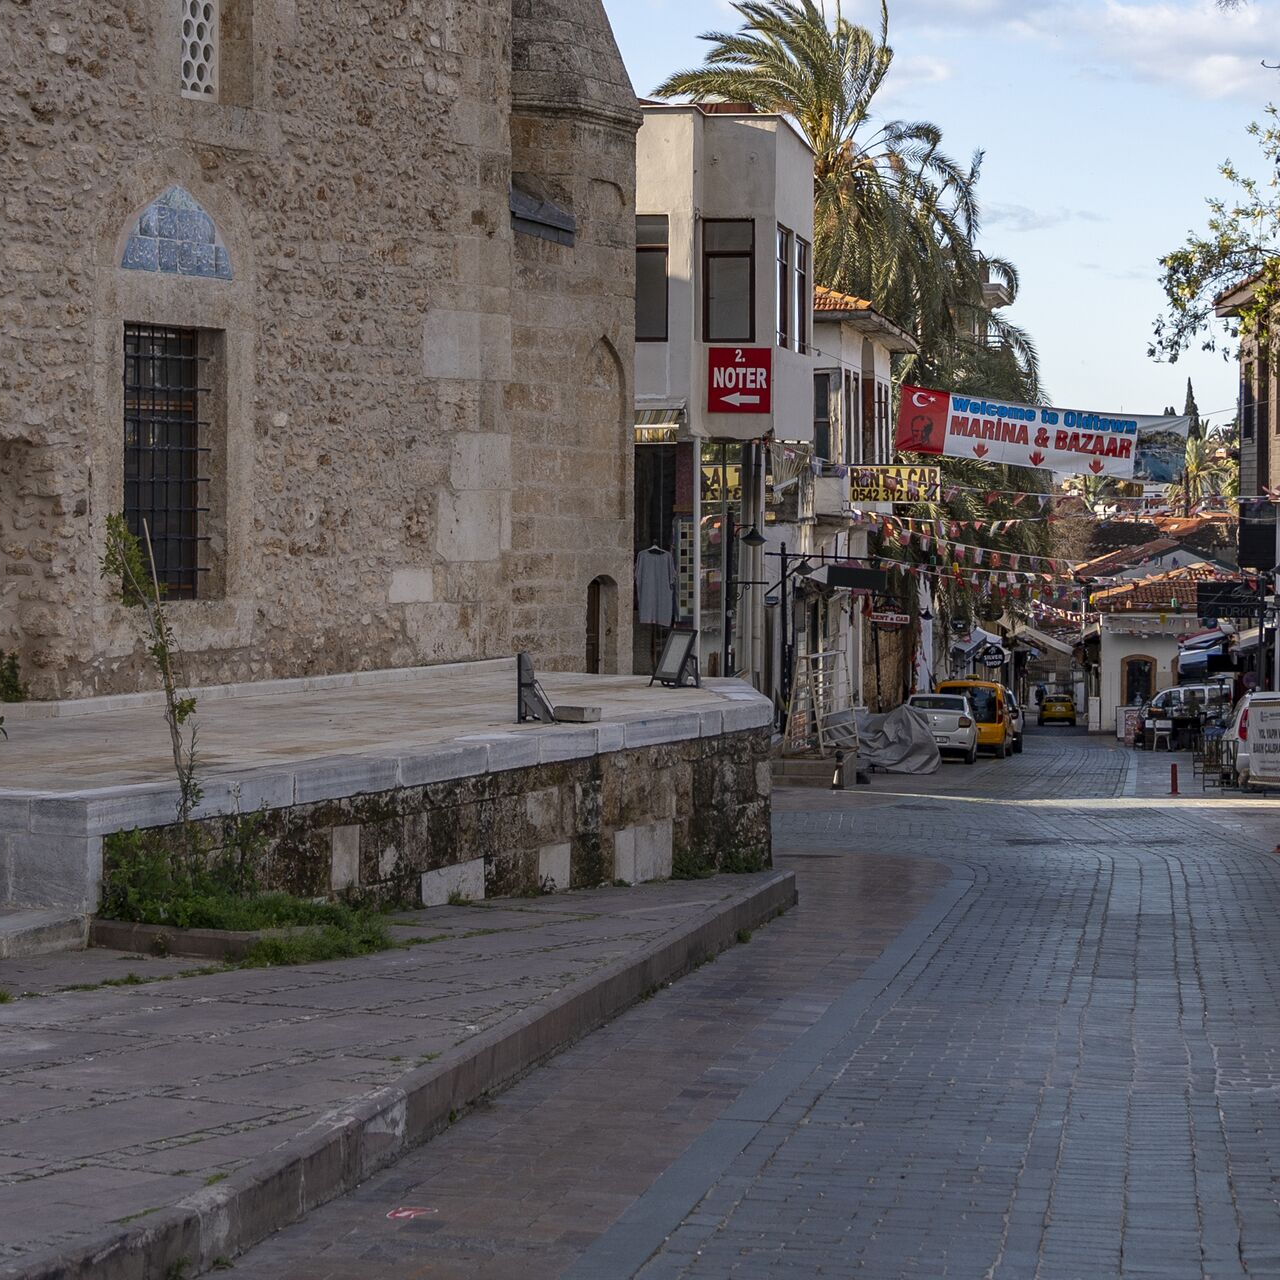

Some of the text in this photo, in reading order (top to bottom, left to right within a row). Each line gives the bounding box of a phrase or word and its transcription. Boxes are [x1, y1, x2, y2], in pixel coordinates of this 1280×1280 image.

[735, 349, 746, 362] 2.
[713, 367, 767, 388] NOTER
[951, 397, 1137, 435] Welcome to Oldtown
[950, 415, 1133, 459] MARİNA & BAZAAR
[850, 468, 938, 488] RENT A CAR
[852, 489, 880, 501] 0542
